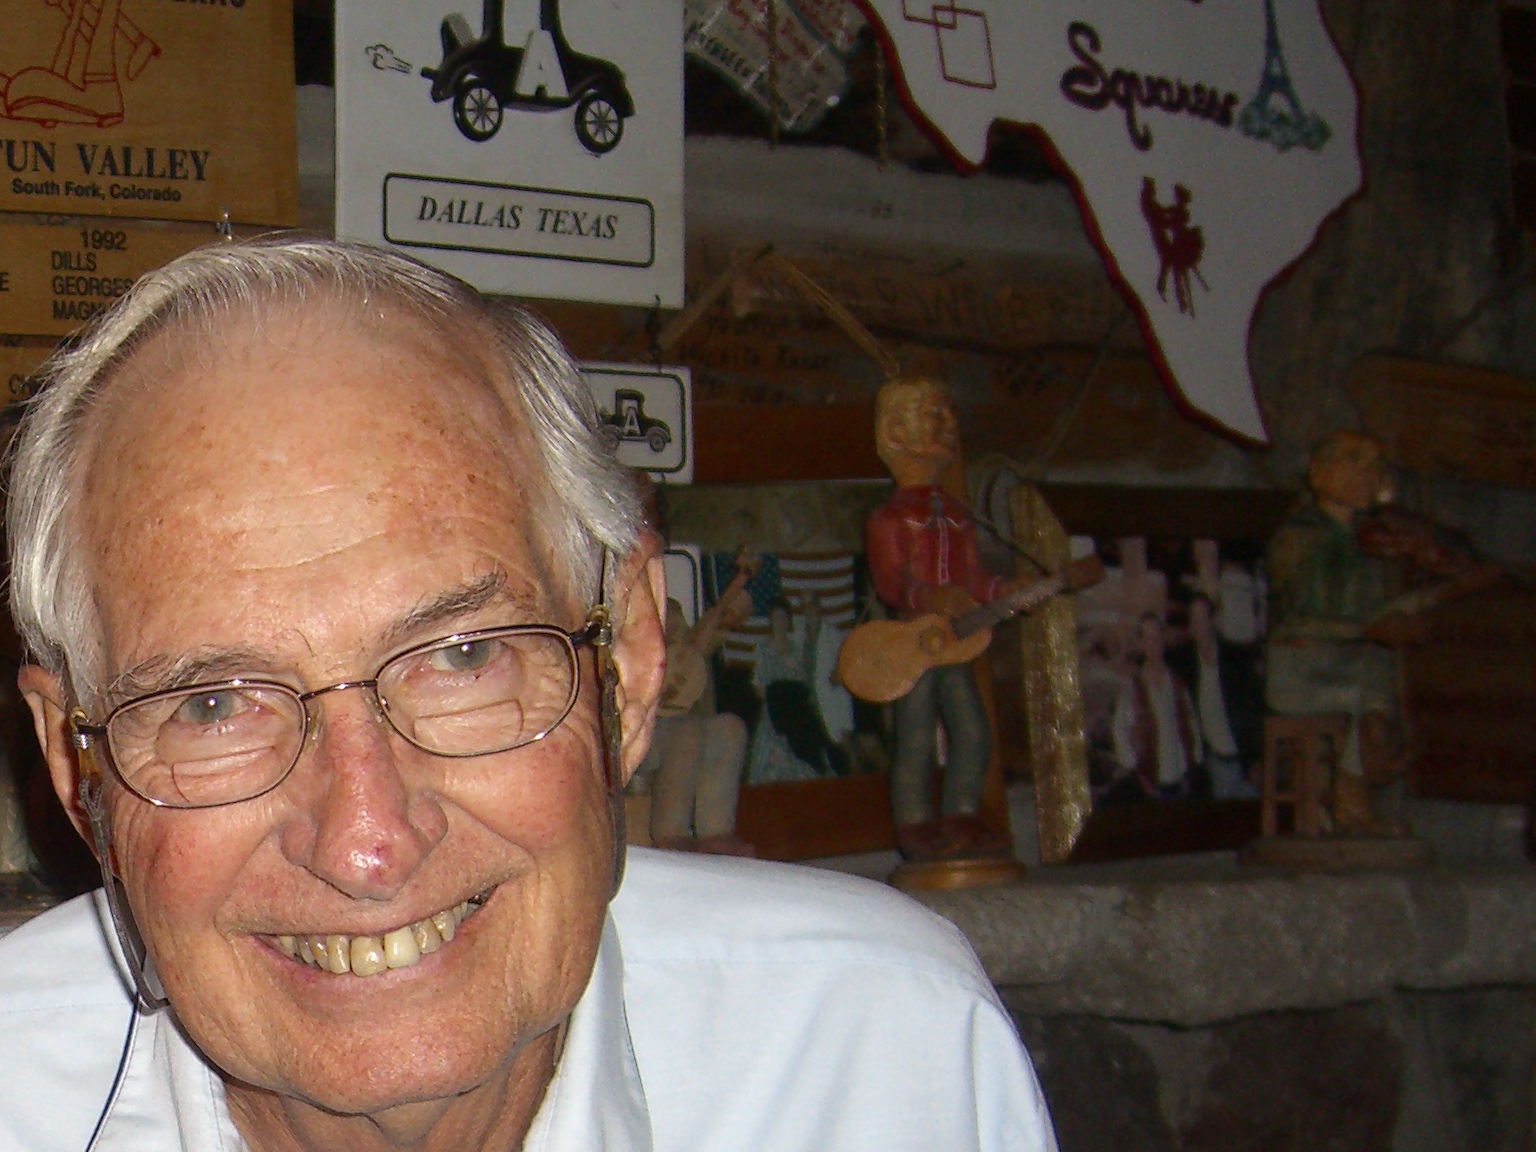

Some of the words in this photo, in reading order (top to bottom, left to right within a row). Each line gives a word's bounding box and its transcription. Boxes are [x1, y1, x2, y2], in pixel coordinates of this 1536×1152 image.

[1060, 20, 1239, 153] Squares
[76, 142, 210, 182] VALLEY
[12, 178, 60, 196] South
[65, 179, 106, 200] Fork,
[109, 183, 182, 201] Colorado
[417, 196, 523, 230] DALLAS
[536, 208, 618, 239] TEXAS
[81, 229, 127, 251] 1992
[51, 250, 97, 271] DILLS
